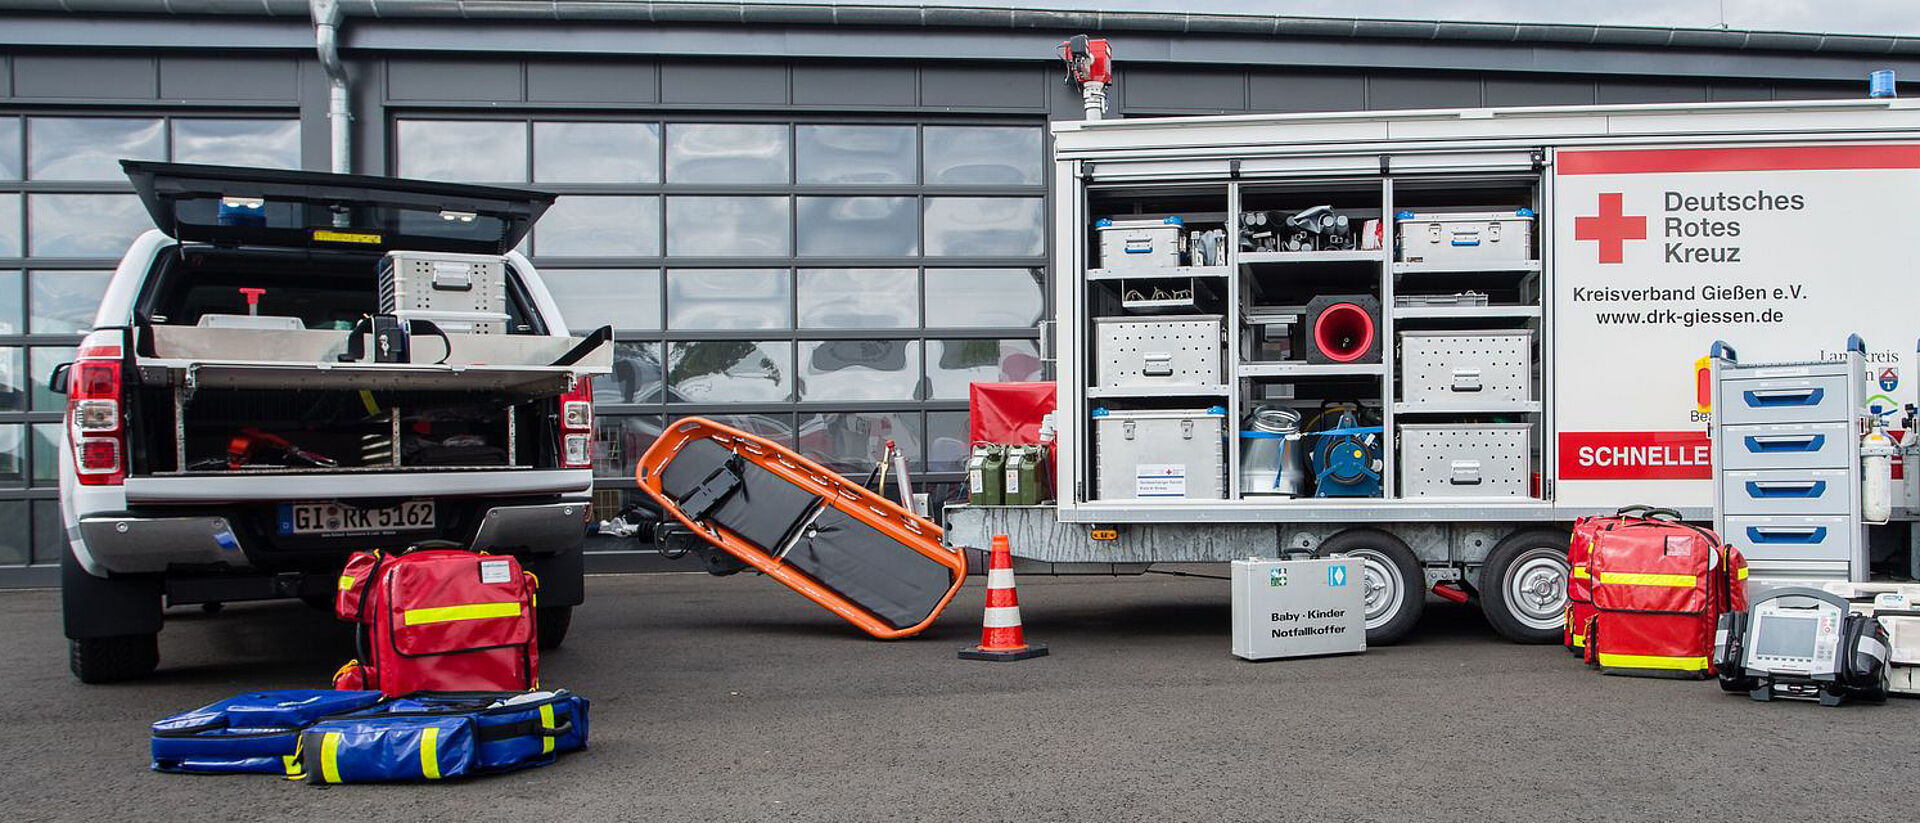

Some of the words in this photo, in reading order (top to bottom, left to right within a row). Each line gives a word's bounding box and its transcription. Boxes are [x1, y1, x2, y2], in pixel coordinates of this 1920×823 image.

[1664, 190, 1804, 212] Deutsches
[1664, 217, 1741, 238] Rotes
[1664, 243, 1741, 263] Kreuz
[1573, 286, 1695, 302] Kreisverband
[1702, 284, 1767, 300] Gießen
[1772, 284, 1808, 300] e.V.
[1596, 308, 1784, 327] www.drk-giessen.de
[1820, 349, 1899, 363] Lanreis
[1578, 447, 1711, 467] SCHNELLE
[296, 507, 324, 530] GI
[344, 508, 372, 528] RK
[379, 504, 434, 527] 5162
[1271, 612, 1300, 622] Baby
[1307, 609, 1345, 619] Kinder
[1271, 625, 1346, 638] Notfallkoffer
